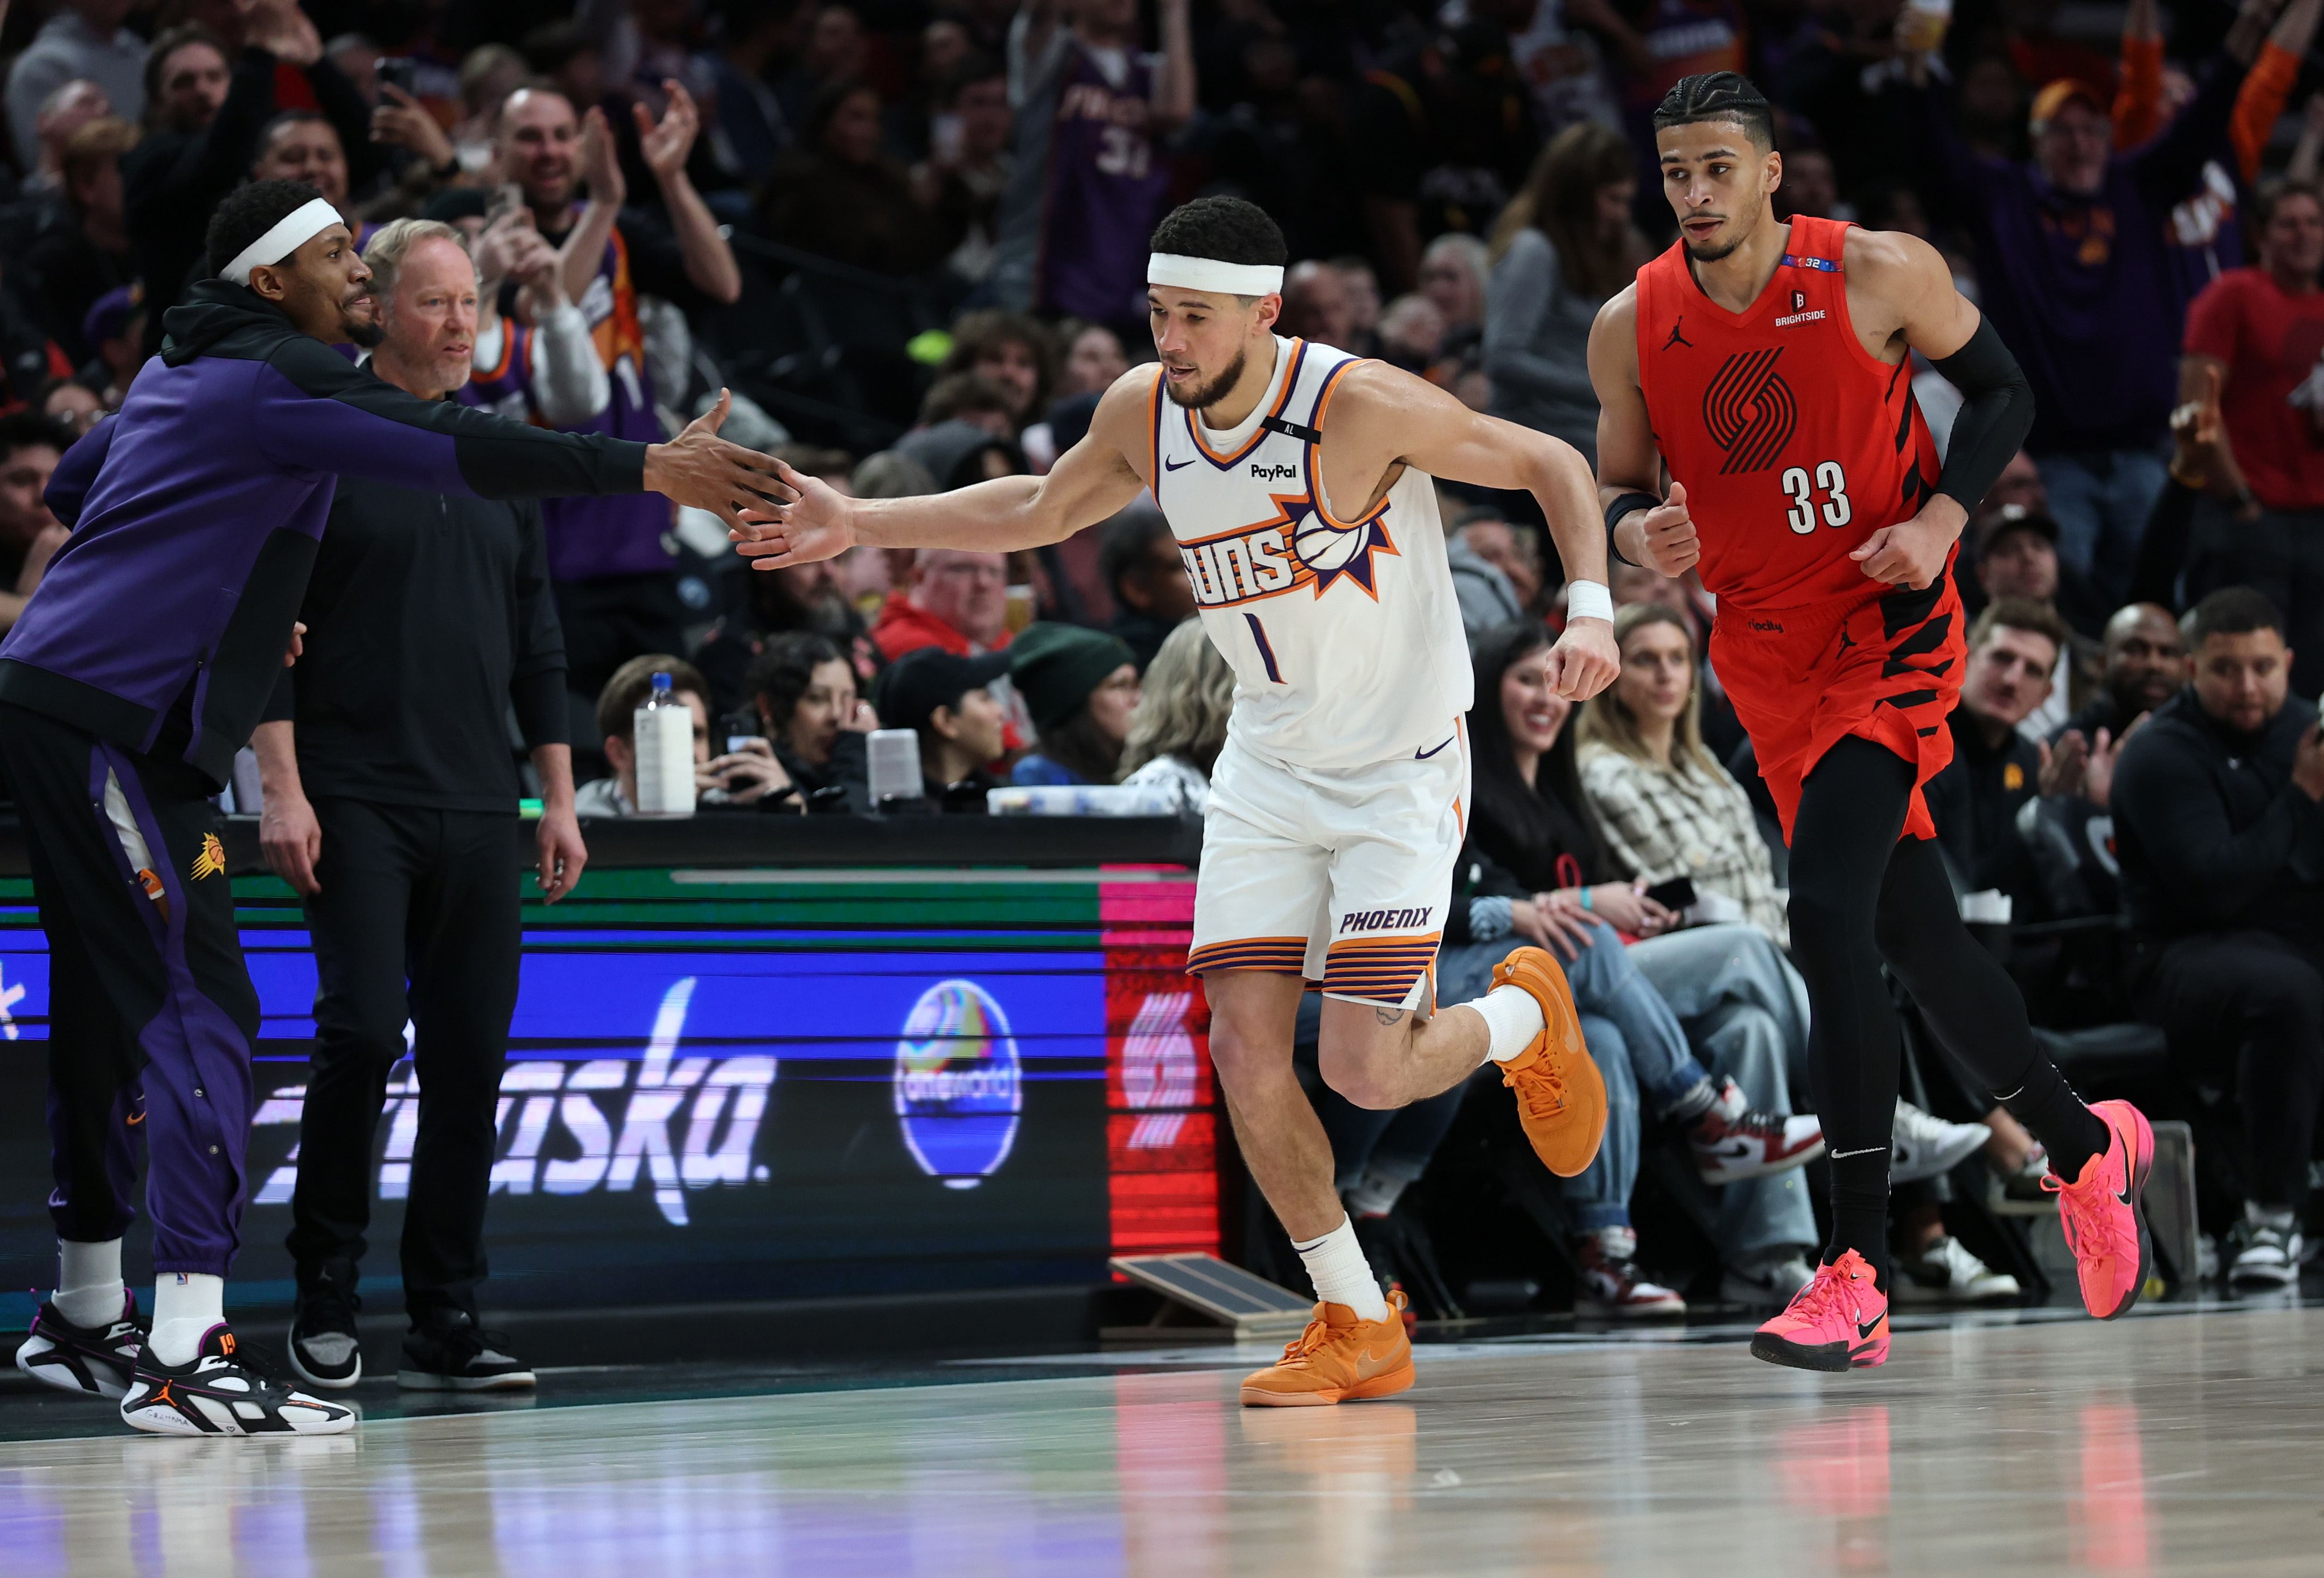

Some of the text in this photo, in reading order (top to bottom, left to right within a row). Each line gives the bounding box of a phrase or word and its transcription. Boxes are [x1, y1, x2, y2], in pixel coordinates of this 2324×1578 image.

[1805, 258, 1820, 268] 32
[1796, 294, 1804, 308] B
[1775, 310, 1826, 326] BRIGHTSIDE
[1284, 423, 1294, 435] AL
[1251, 464, 1296, 482] PayPal
[1781, 460, 1852, 535] 33
[1241, 612, 1288, 685] 1
[1339, 907, 1433, 934] PHOENIX
